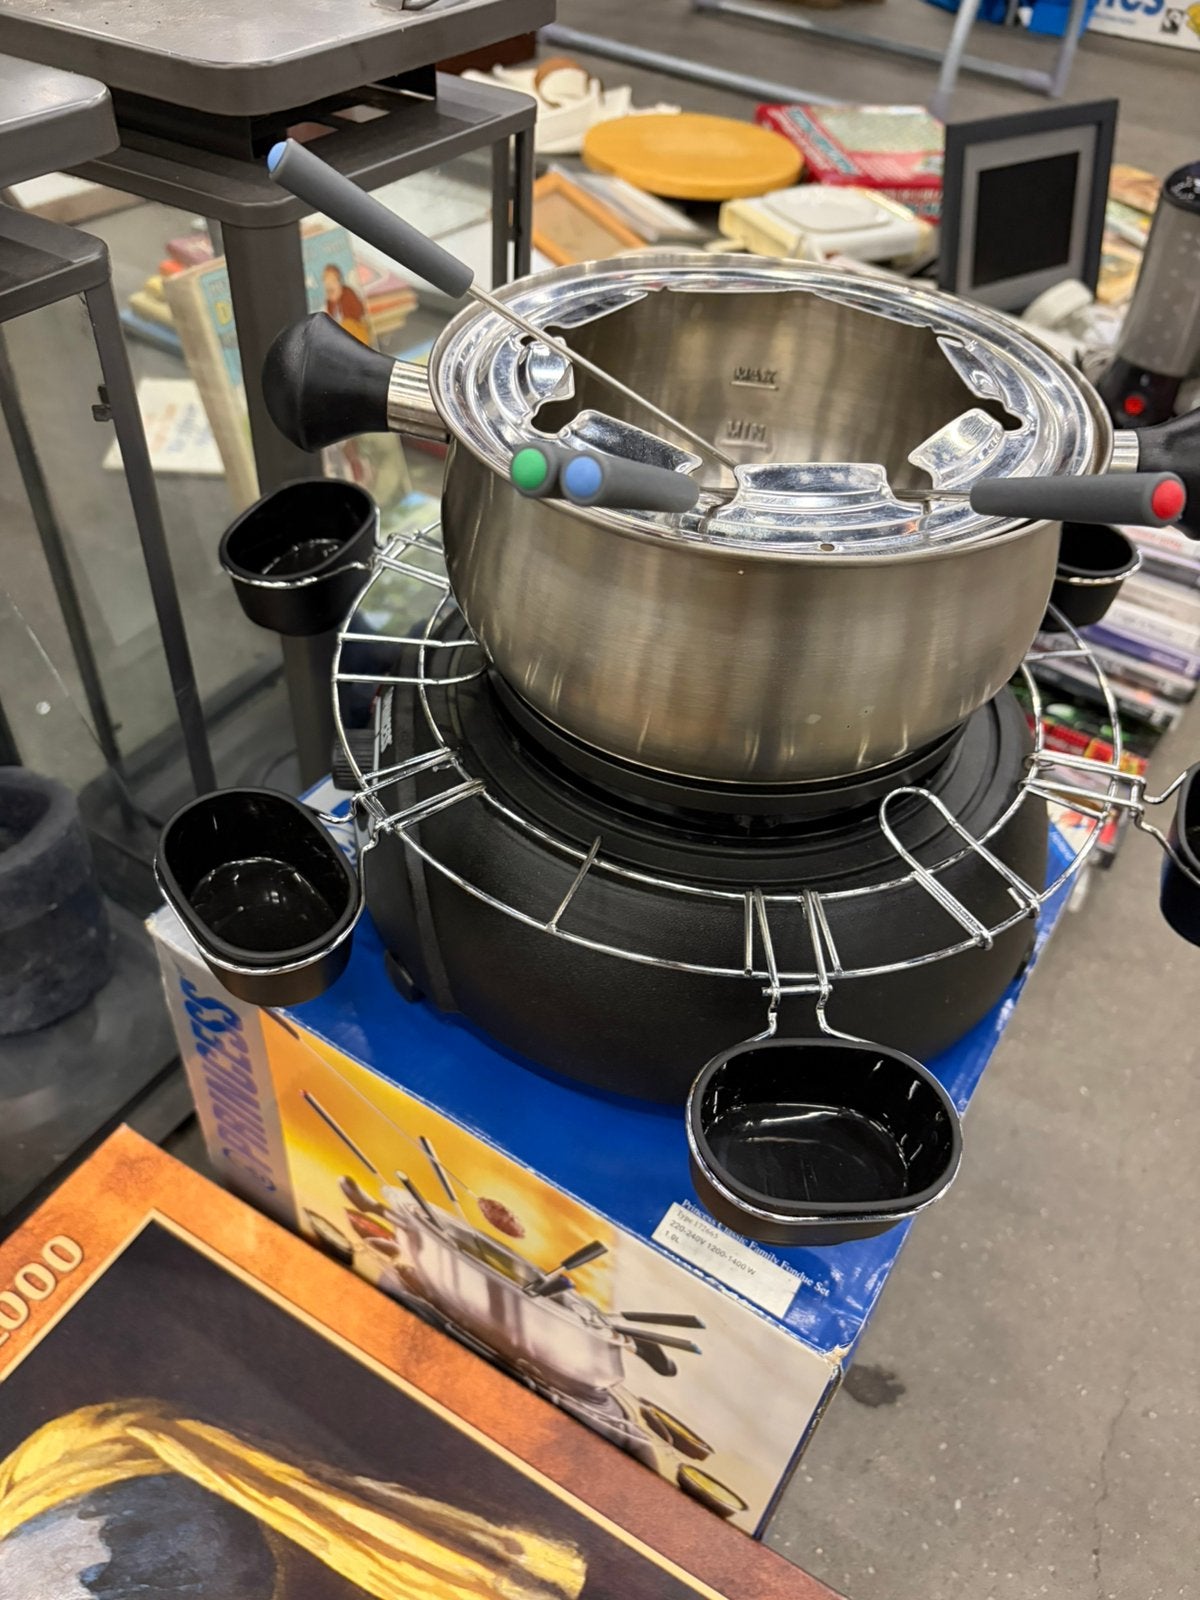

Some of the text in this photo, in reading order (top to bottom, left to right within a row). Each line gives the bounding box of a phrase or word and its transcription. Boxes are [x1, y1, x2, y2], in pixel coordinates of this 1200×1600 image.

[727, 420, 767, 441] MIN
[180, 976, 274, 1176] PRINCESS
[675, 1209, 695, 1226] Type
[669, 1219, 757, 1276] 220-240V 1200-1400 W
[681, 1199, 717, 1228] Princess
[749, 1240, 780, 1266] Family
[779, 1256, 814, 1287] Fondue
[813, 1281, 831, 1298] Set
